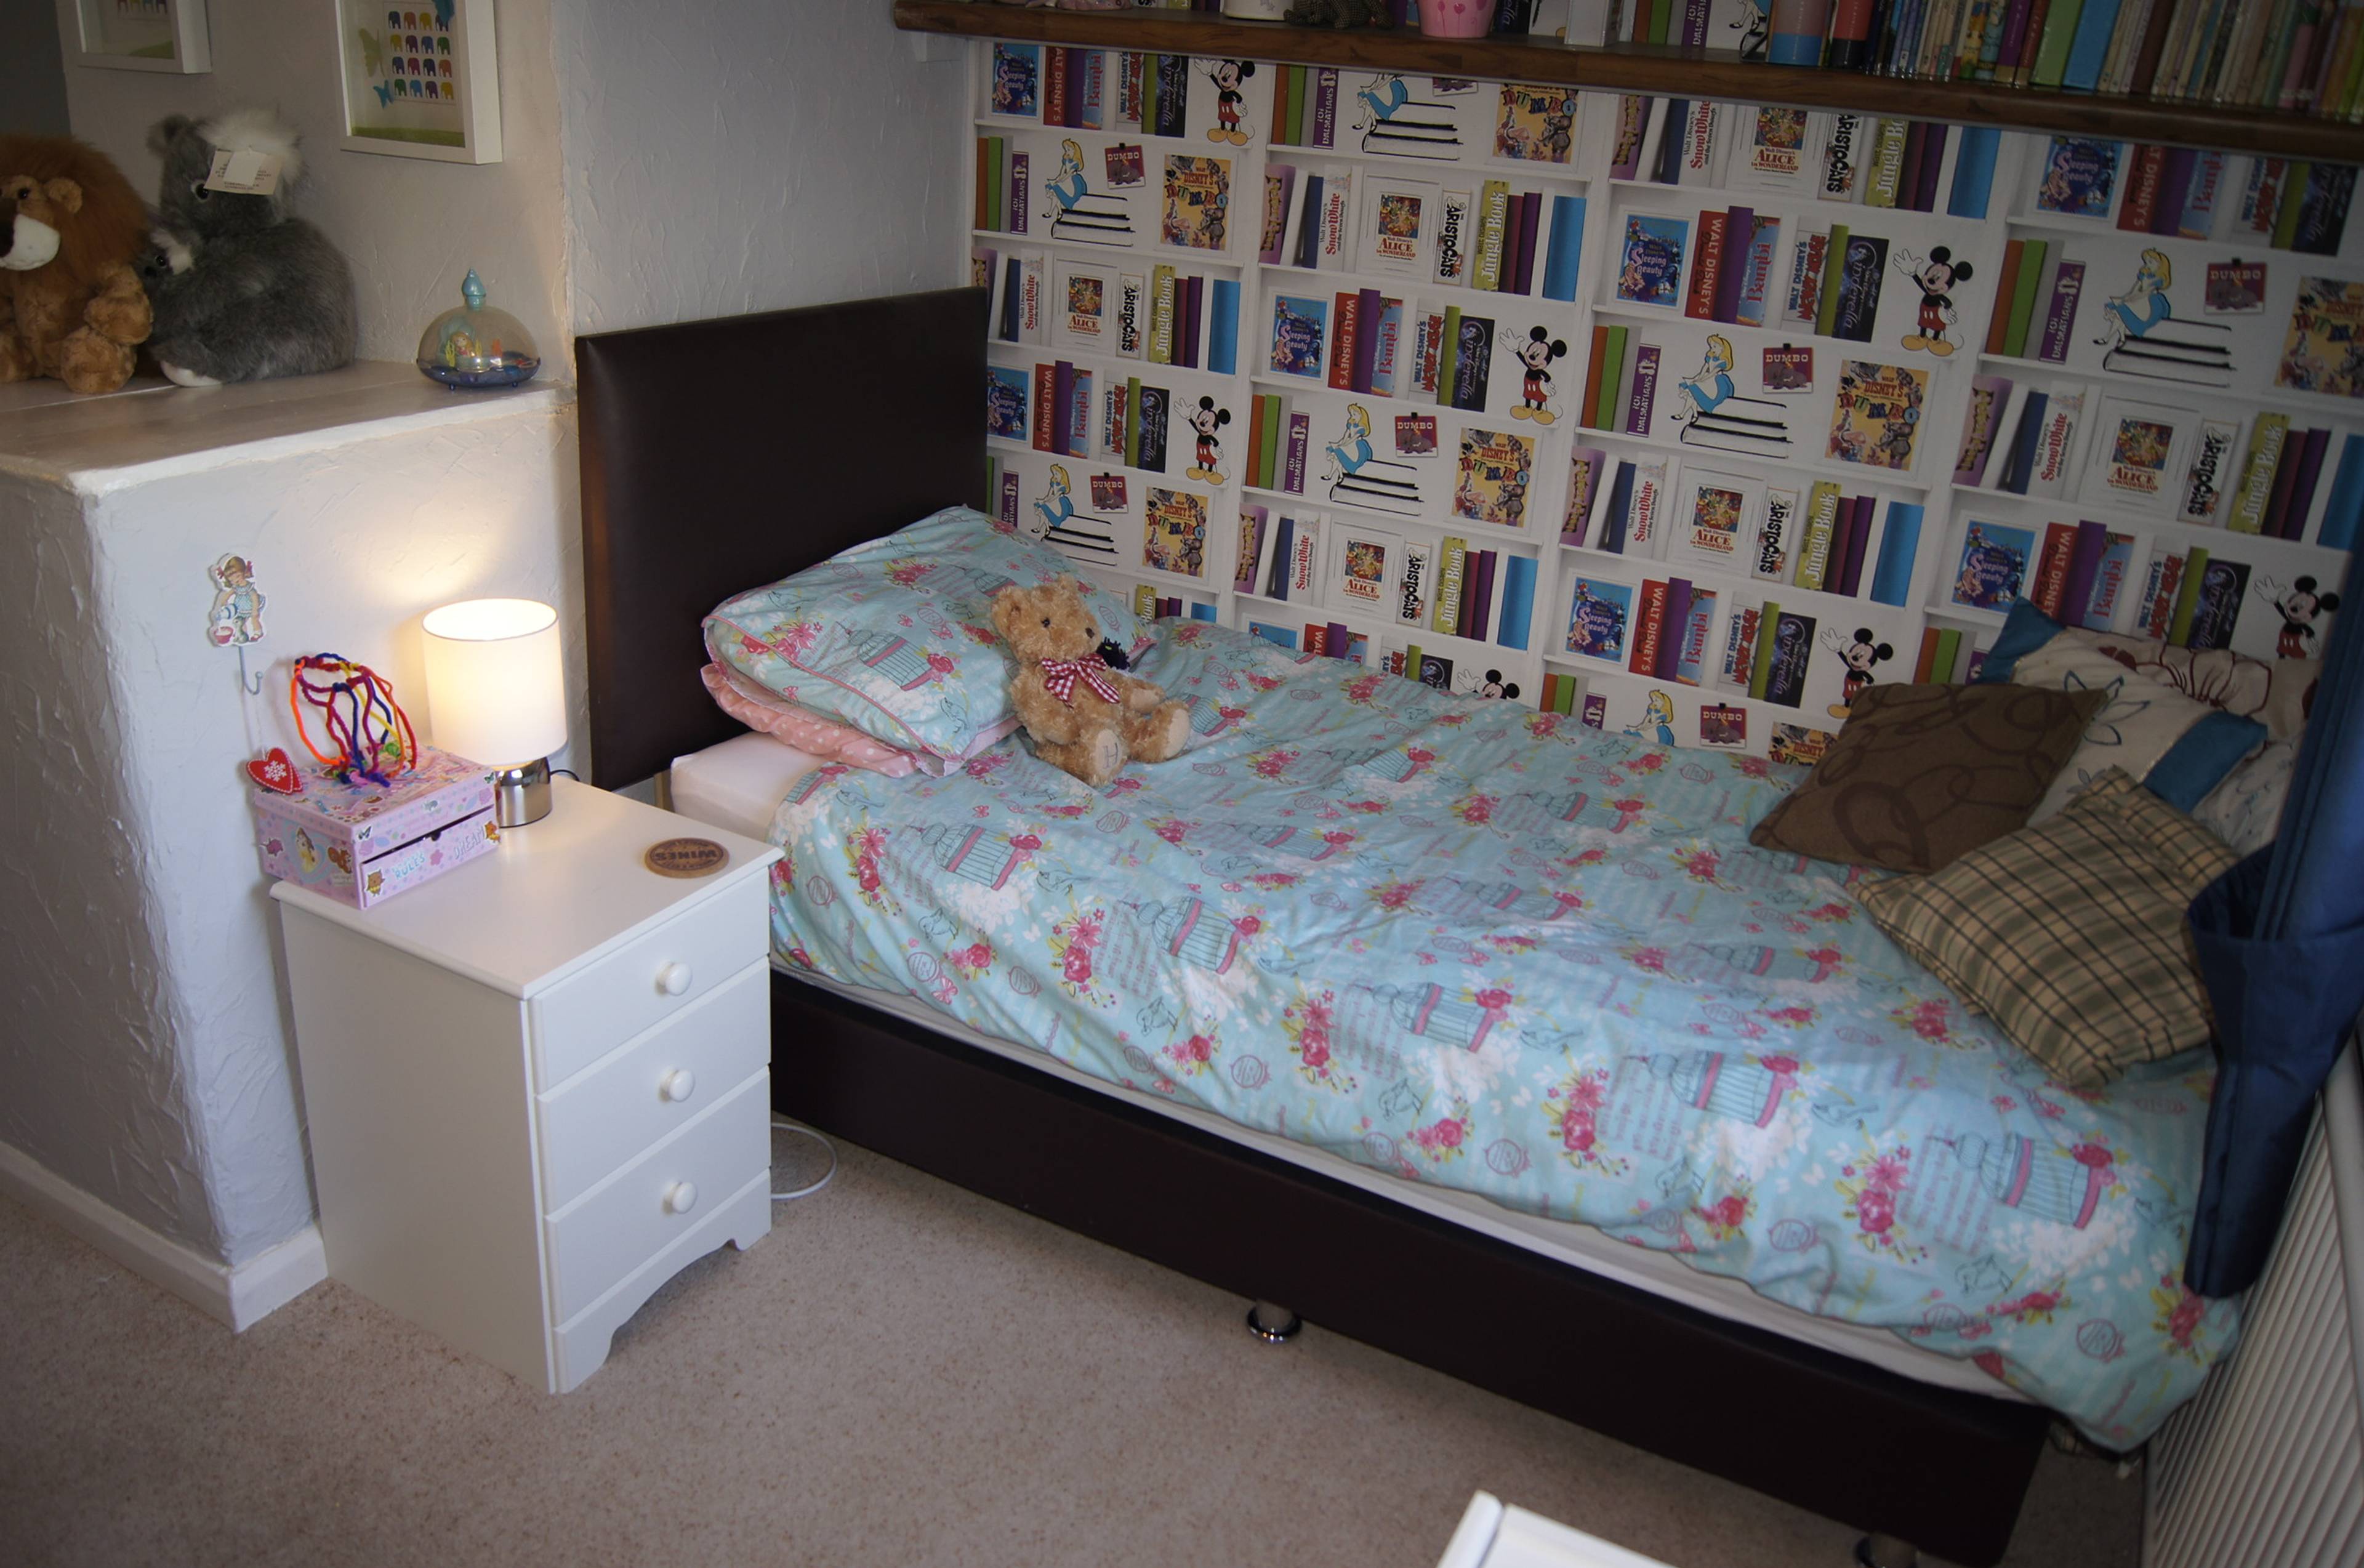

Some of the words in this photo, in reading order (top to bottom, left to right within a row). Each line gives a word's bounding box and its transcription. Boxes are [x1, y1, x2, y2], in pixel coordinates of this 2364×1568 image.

[1687, 5, 1696, 20] 101
[1055, 47, 1064, 67] ALT
[1322, 87, 1334, 145] DALMATIANS
[1499, 90, 1578, 117] DUMBO
[1695, 100, 1711, 135] White
[1107, 152, 1139, 160] DUMBO
[1691, 134, 1707, 169] Snow
[1755, 149, 1796, 164] ALICE
[1826, 111, 1857, 193] ARISTOCATS
[1875, 140, 1904, 198] Jungle
[1329, 193, 1340, 224] White
[1487, 191, 1506, 228] Book
[1325, 223, 1338, 255] Snow
[1378, 238, 1413, 252] ALICE
[1439, 204, 1462, 278] ARISTOCATS
[1707, 218, 1723, 254] WALT
[1481, 230, 1503, 282] Jungle
[1630, 247, 1668, 269] Sleeping
[1636, 265, 1663, 276] Beauty
[1790, 241, 1808, 284] DISNEY'S
[1698, 259, 1716, 315] DISNEY'S
[1747, 243, 1775, 303] Bambi
[1788, 286, 1800, 310] WALT
[1069, 315, 1098, 328] ALICE
[1344, 299, 1355, 332] WALT
[1280, 324, 1311, 345] Sleeping
[1285, 340, 1308, 351] Beauty
[1378, 321, 1399, 376] Bambi
[1413, 320, 1427, 360] DISNEY'S
[1339, 336, 1352, 386] DISNEY'S
[1413, 361, 1423, 383] WALT
[1043, 369, 1051, 400] WALT
[1863, 380, 1904, 398] DISNEY'S
[1075, 390, 1090, 440] Bambi
[1632, 395, 1641, 410] 101
[1637, 376, 1653, 432] DALMATIANS
[1834, 393, 1922, 425] DUMBO
[1042, 403, 1050, 448] DISNEY'S
[1293, 440, 1304, 491] DALMATIANS
[1481, 446, 1514, 462] DISNEY'S
[1457, 457, 1530, 486] DUMBO
[1639, 481, 1654, 512] White
[1814, 491, 1838, 529] Book
[1634, 511, 1649, 542] Snow
[1693, 529, 1732, 545] ALICE
[1759, 502, 1788, 574] ARISTOCATS
[1298, 535, 1309, 563] White
[1445, 546, 1464, 580] Book
[1804, 530, 1831, 582] Jungle
[1296, 562, 1307, 590] Snow
[1345, 578, 1377, 593] ALICE
[1402, 555, 1423, 620] ARISTOCATS
[1440, 581, 1460, 627] Jungle
[1649, 587, 1663, 619] WALT
[1641, 622, 1658, 672] DISNEY'S
[1686, 611, 1711, 665] Bambi
[1725, 613, 1742, 652] DISNEY'S
[1724, 653, 1735, 675] WALT
[1703, 711, 1742, 720] DUMBO
